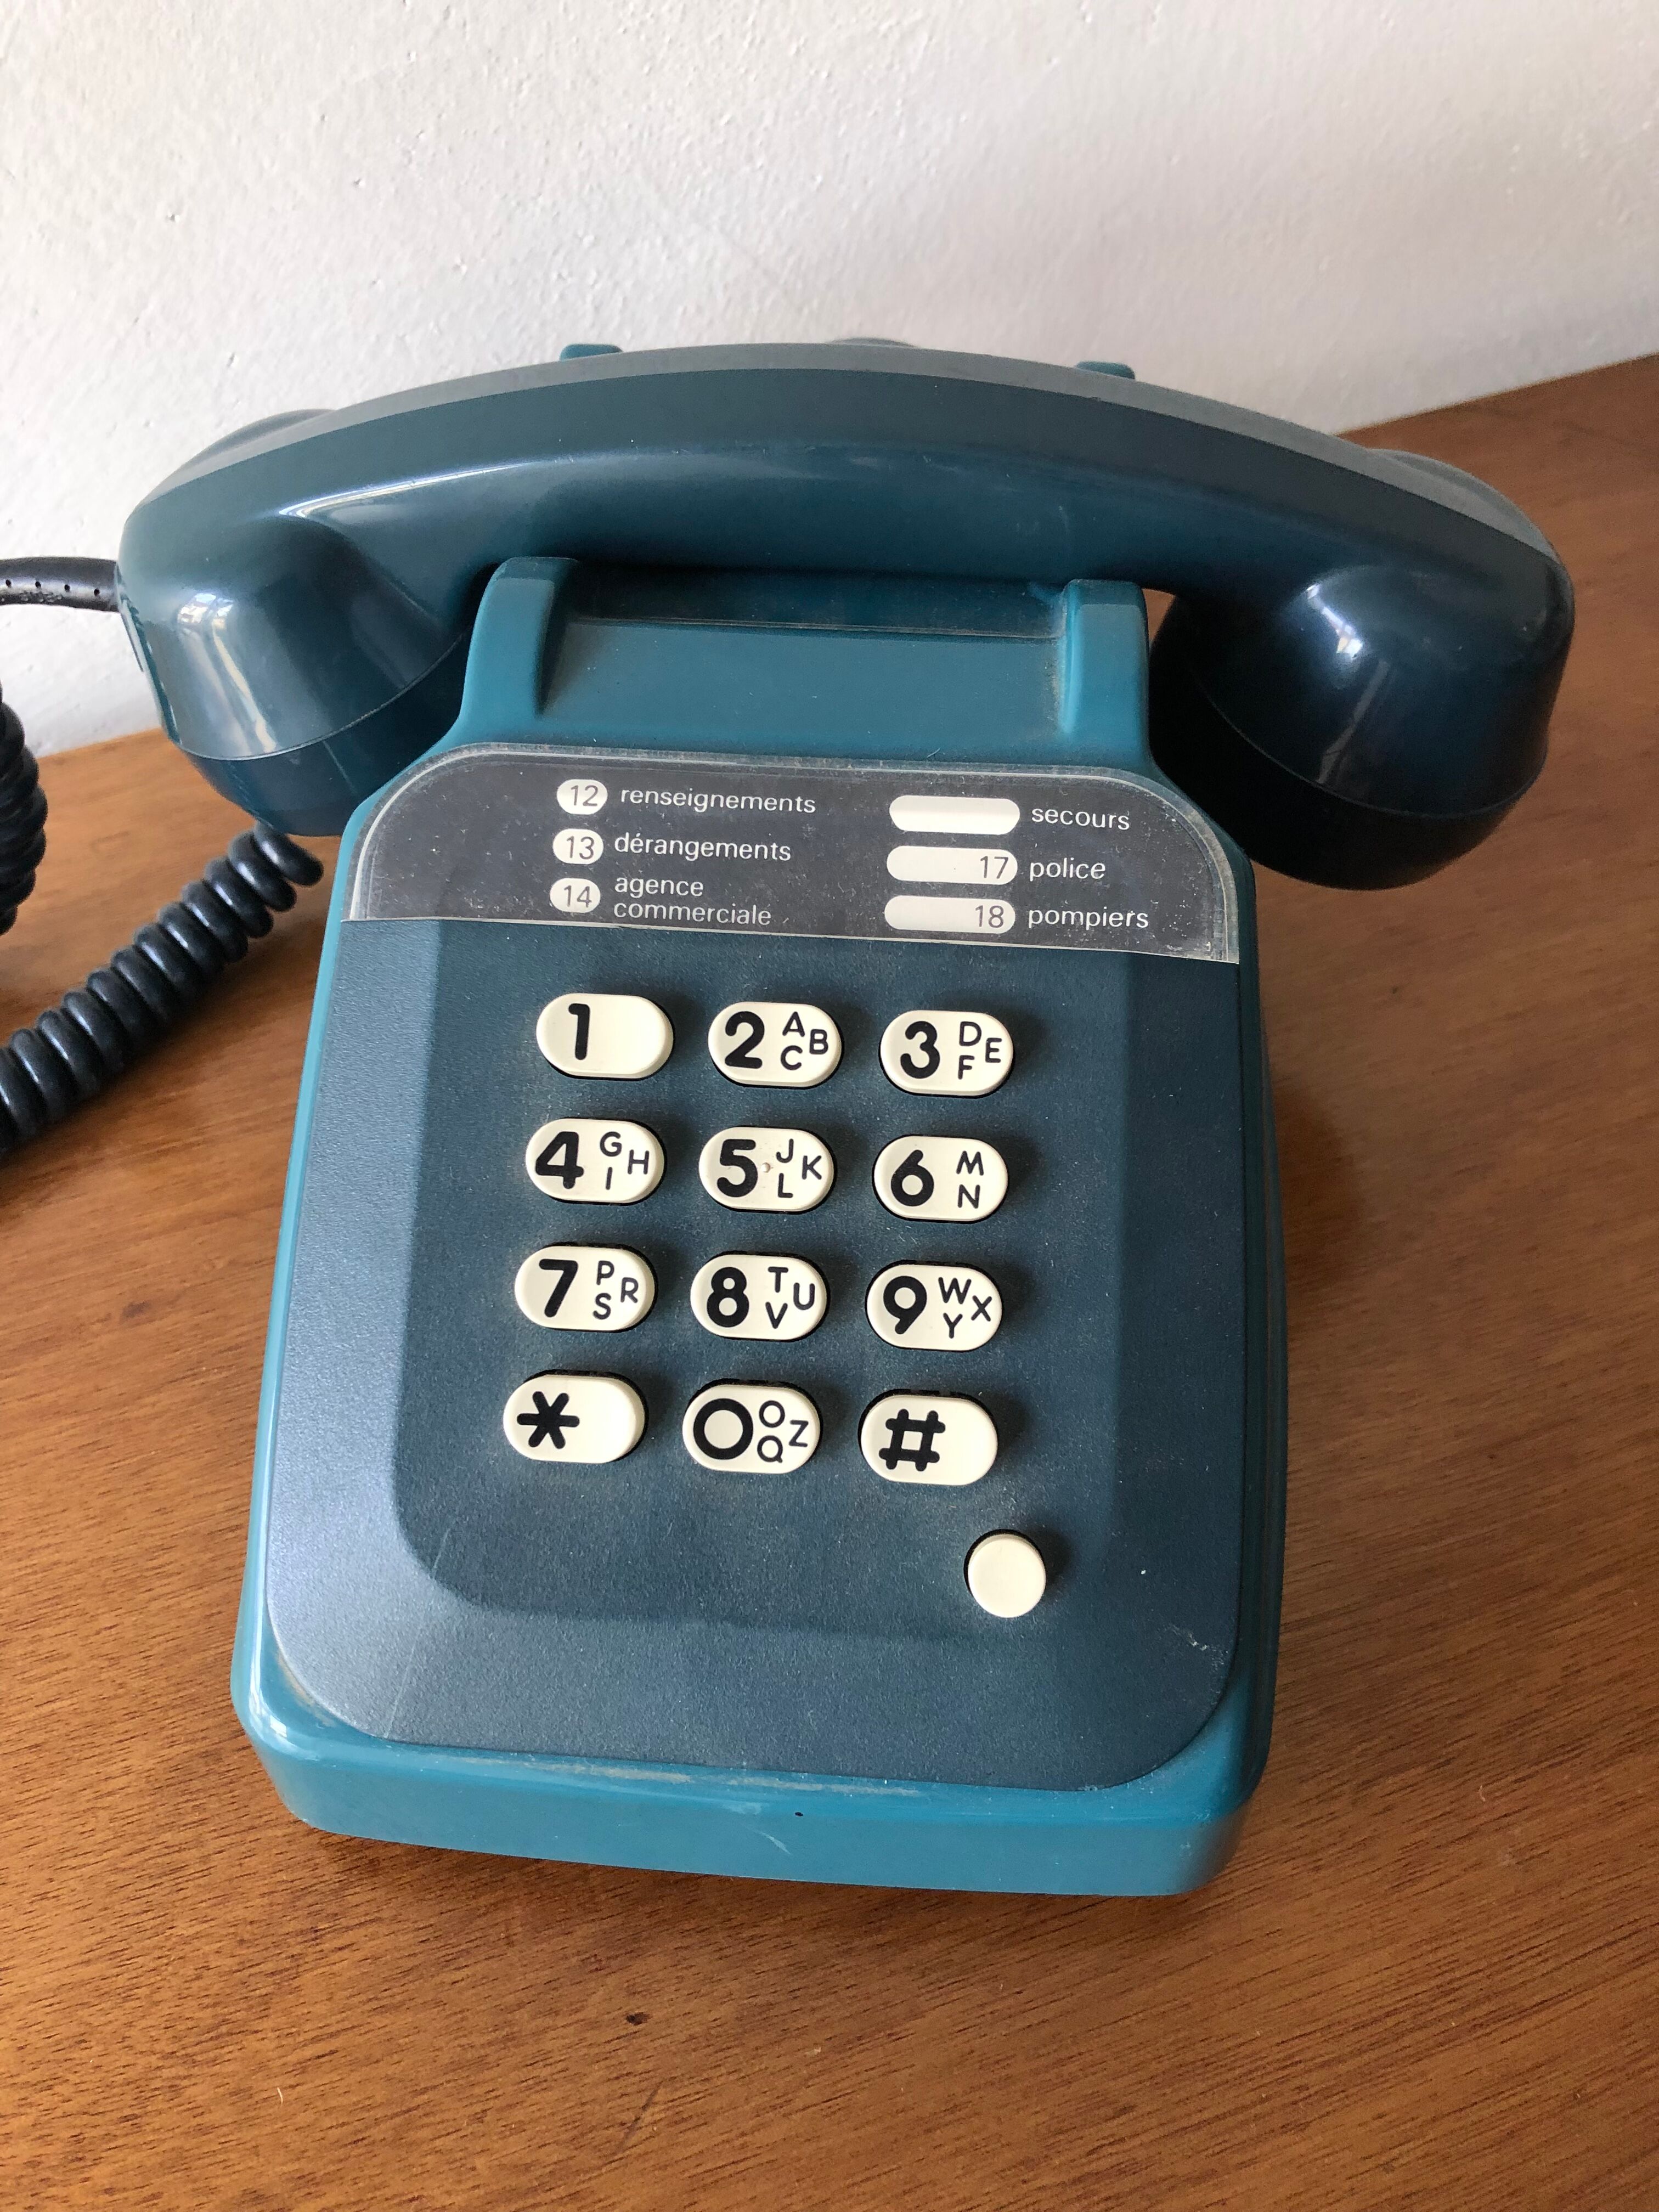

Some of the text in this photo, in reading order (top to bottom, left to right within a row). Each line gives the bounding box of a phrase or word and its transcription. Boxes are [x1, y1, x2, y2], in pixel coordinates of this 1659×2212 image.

[569, 785, 816, 813] 12 renseignements
[1031, 808, 1130, 831] secours
[566, 832, 792, 862] 13 dérangements
[979, 855, 1107, 883] 17 police
[563, 877, 704, 909] 14 agence
[613, 902, 772, 926] commerciale
[975, 905, 1149, 932] 18 pompiers
[568, 1003, 590, 1060] 1
[724, 1011, 765, 1069] 2
[900, 1020, 940, 1079] 3
[535, 1131, 584, 1189] 4
[716, 1138, 758, 1198] 5
[890, 1149, 934, 1207] 6
[538, 1259, 578, 1318] 7
[706, 1266, 749, 1328] 8
[883, 1276, 927, 1335] 9
